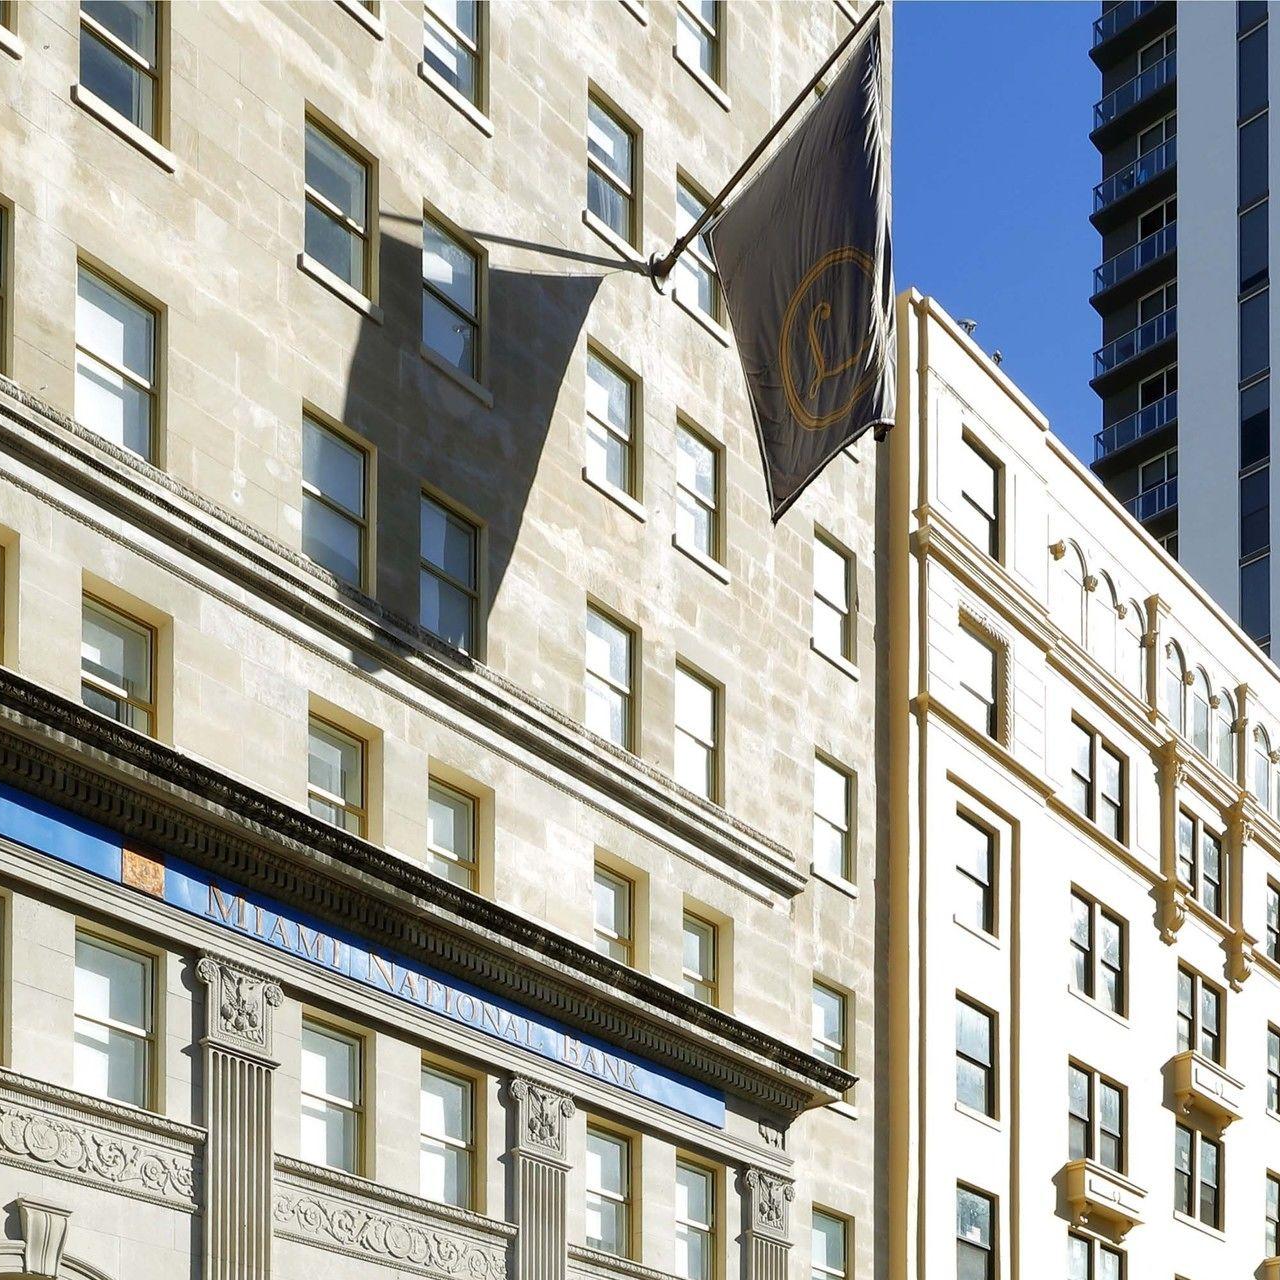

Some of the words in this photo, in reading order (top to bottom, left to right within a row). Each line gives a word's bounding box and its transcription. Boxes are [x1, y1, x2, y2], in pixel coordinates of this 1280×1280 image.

[205, 880, 340, 969] MIAMI
[364, 951, 543, 1051] NATIONAL
[561, 1034, 640, 1092] BANK
